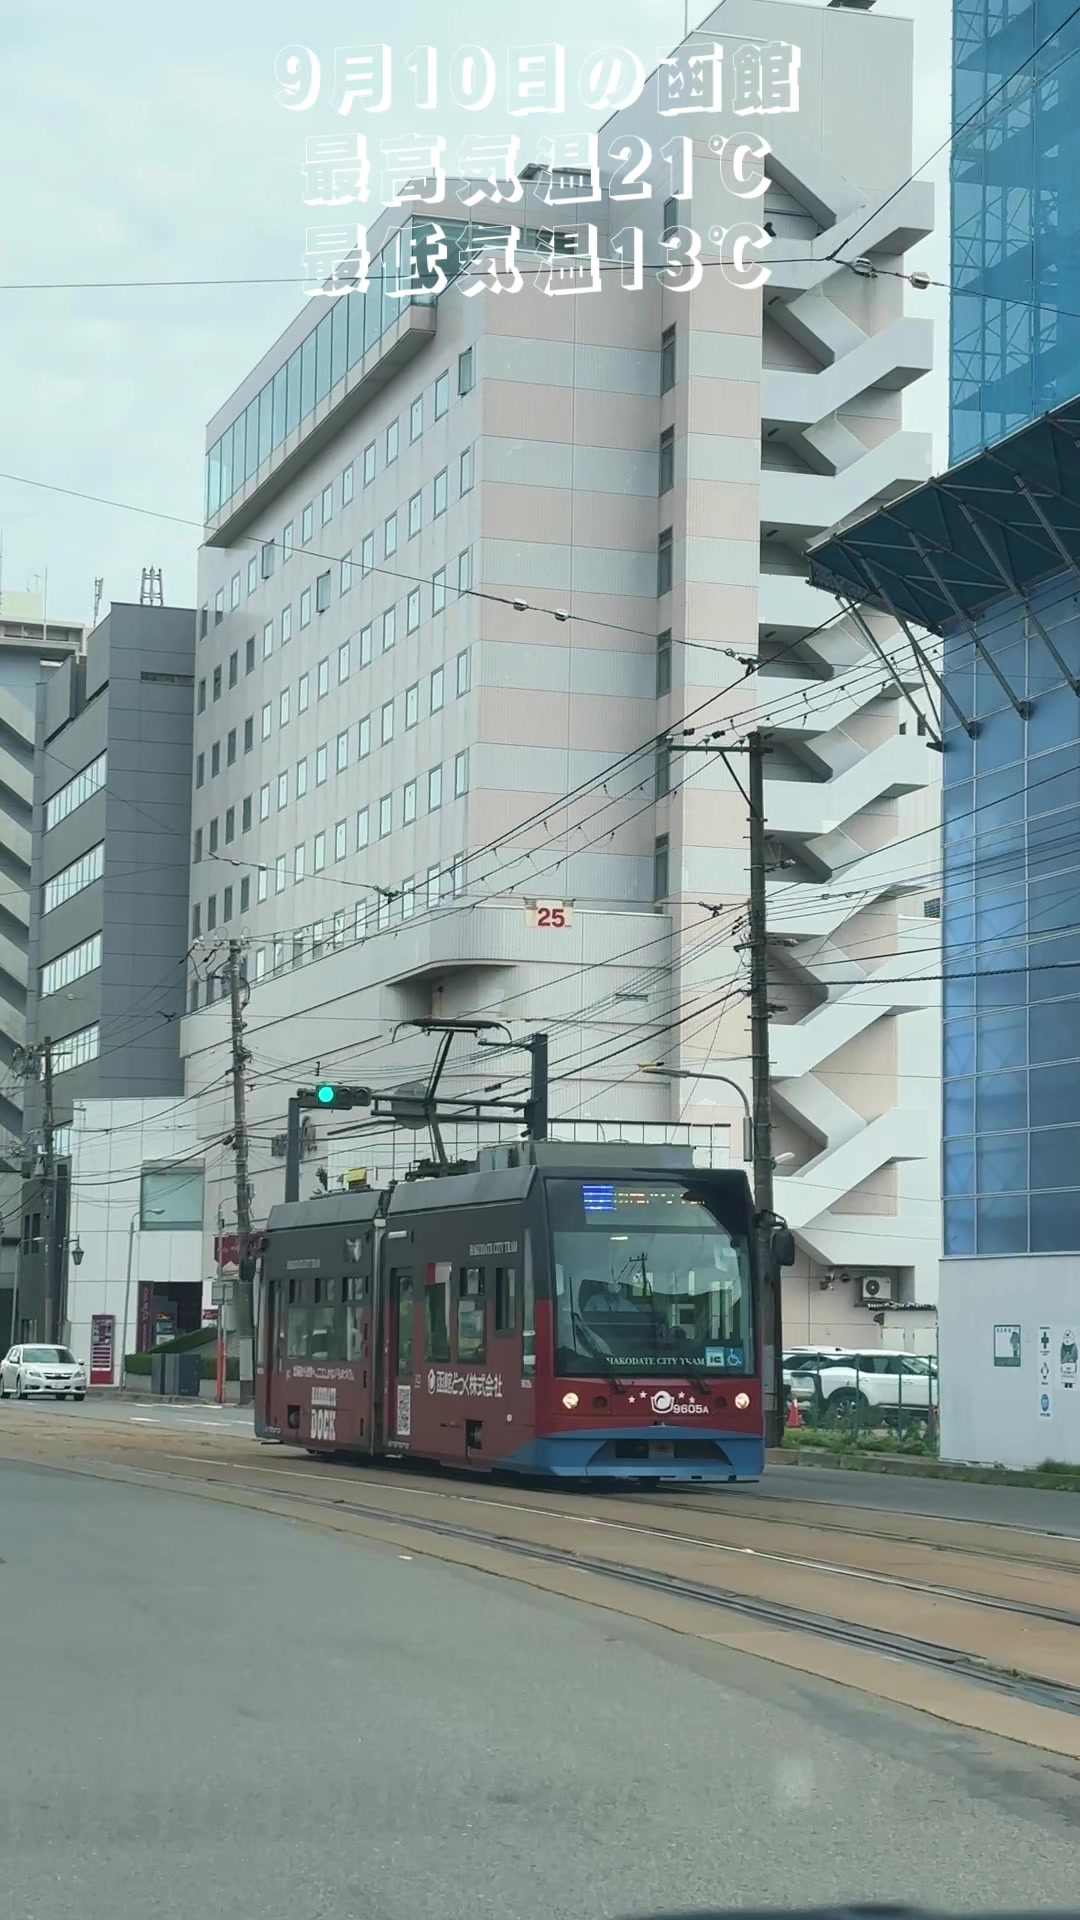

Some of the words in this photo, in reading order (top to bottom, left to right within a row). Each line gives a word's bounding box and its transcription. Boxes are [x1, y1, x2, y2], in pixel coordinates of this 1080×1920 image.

[537, 907, 566, 928] 25
[656, 1357, 677, 1366] CITY
[673, 1404, 710, 1415] 9605A
[310, 1408, 337, 1441] DOCK
